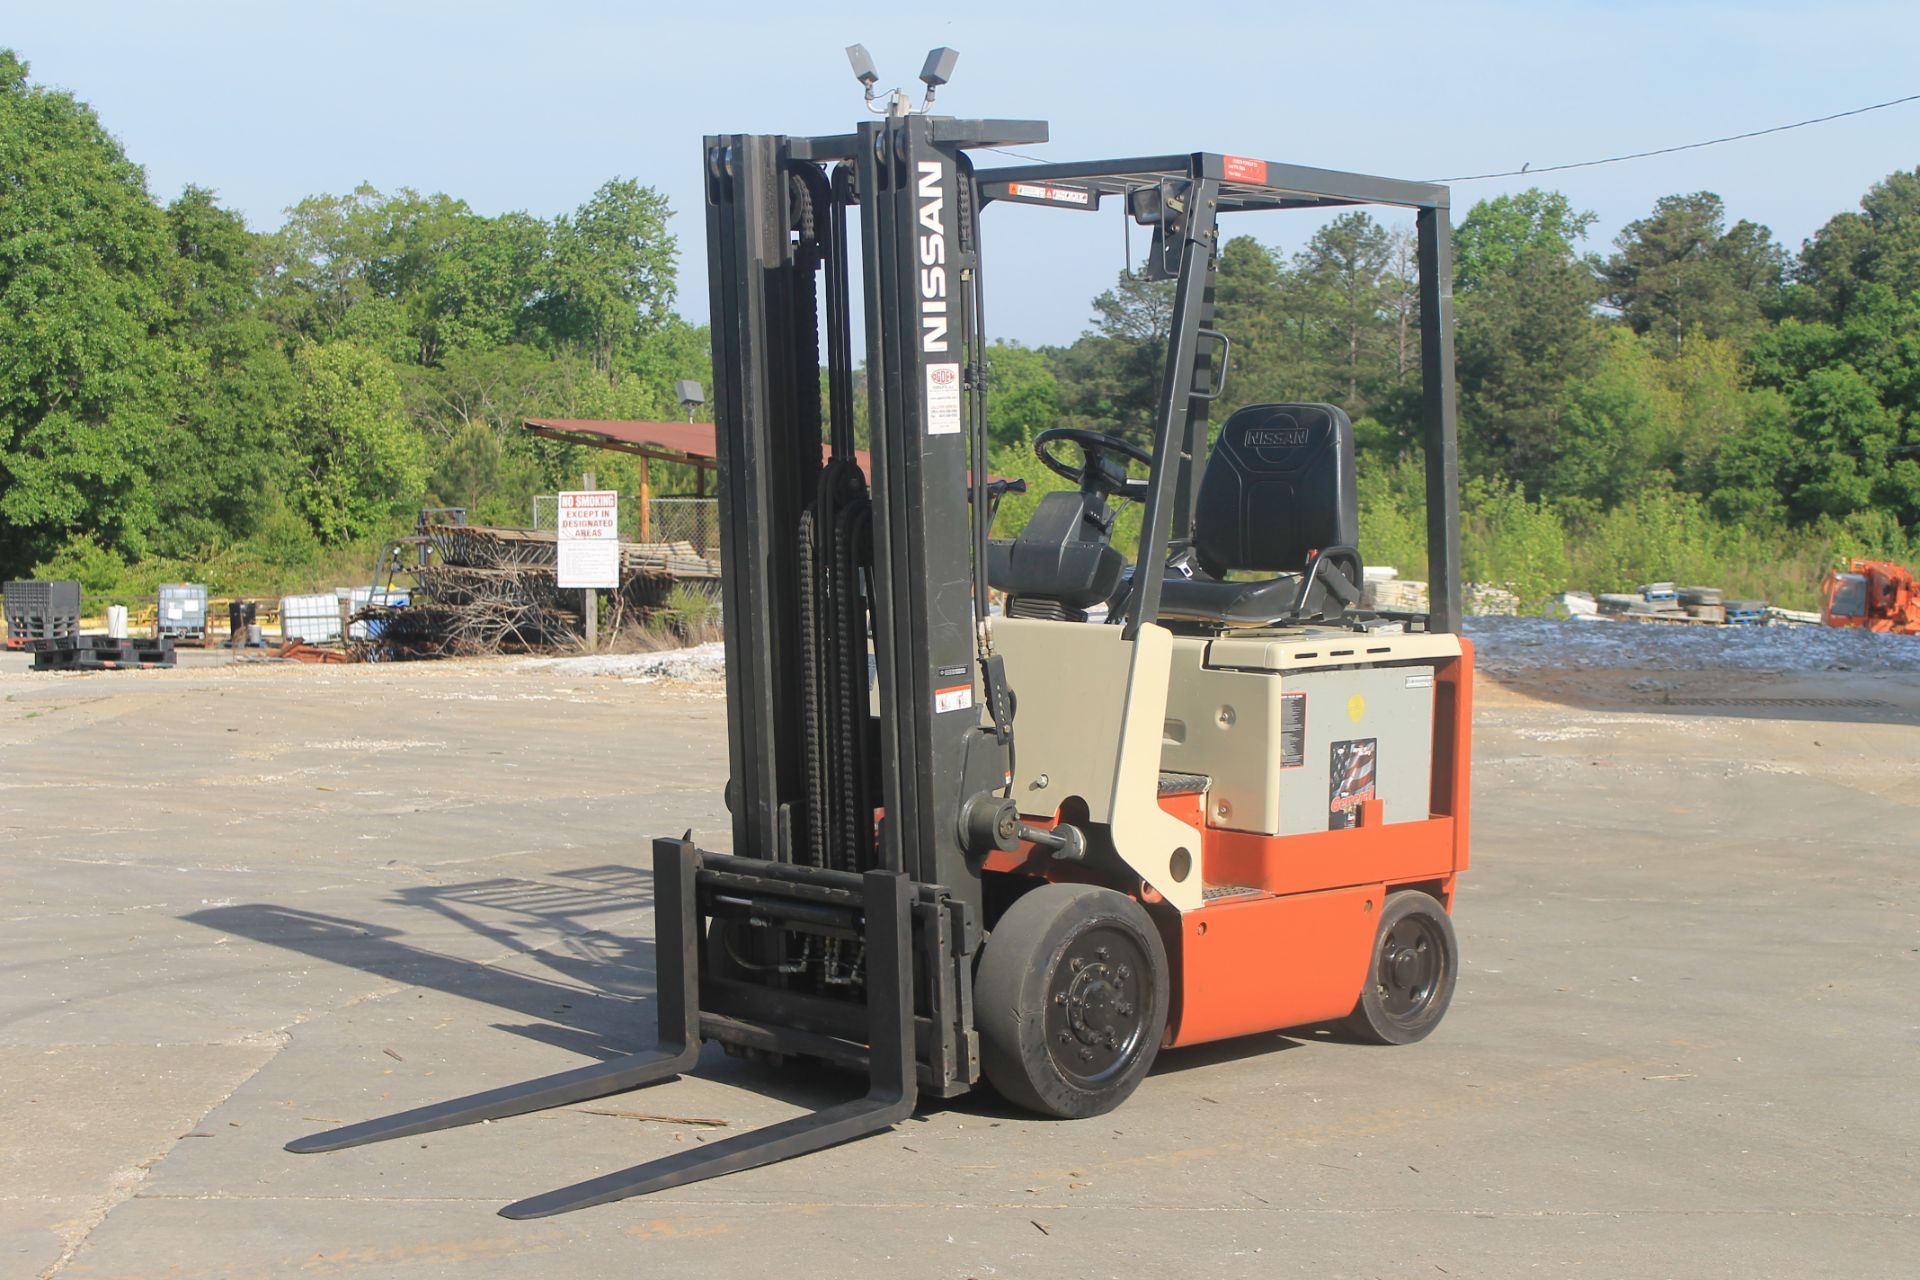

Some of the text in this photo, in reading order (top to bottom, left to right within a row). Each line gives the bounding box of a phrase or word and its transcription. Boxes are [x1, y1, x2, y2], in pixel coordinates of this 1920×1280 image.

[918, 161, 948, 352] NISSAN
[931, 370, 955, 383] OGDEN
[1247, 431, 1306, 445] NISSAN
[562, 495, 614, 507] NO SMOKING
[566, 510, 599, 518] EXCEPT
[562, 519, 613, 528] DESIGNATED
[575, 529, 602, 537] AREAS
